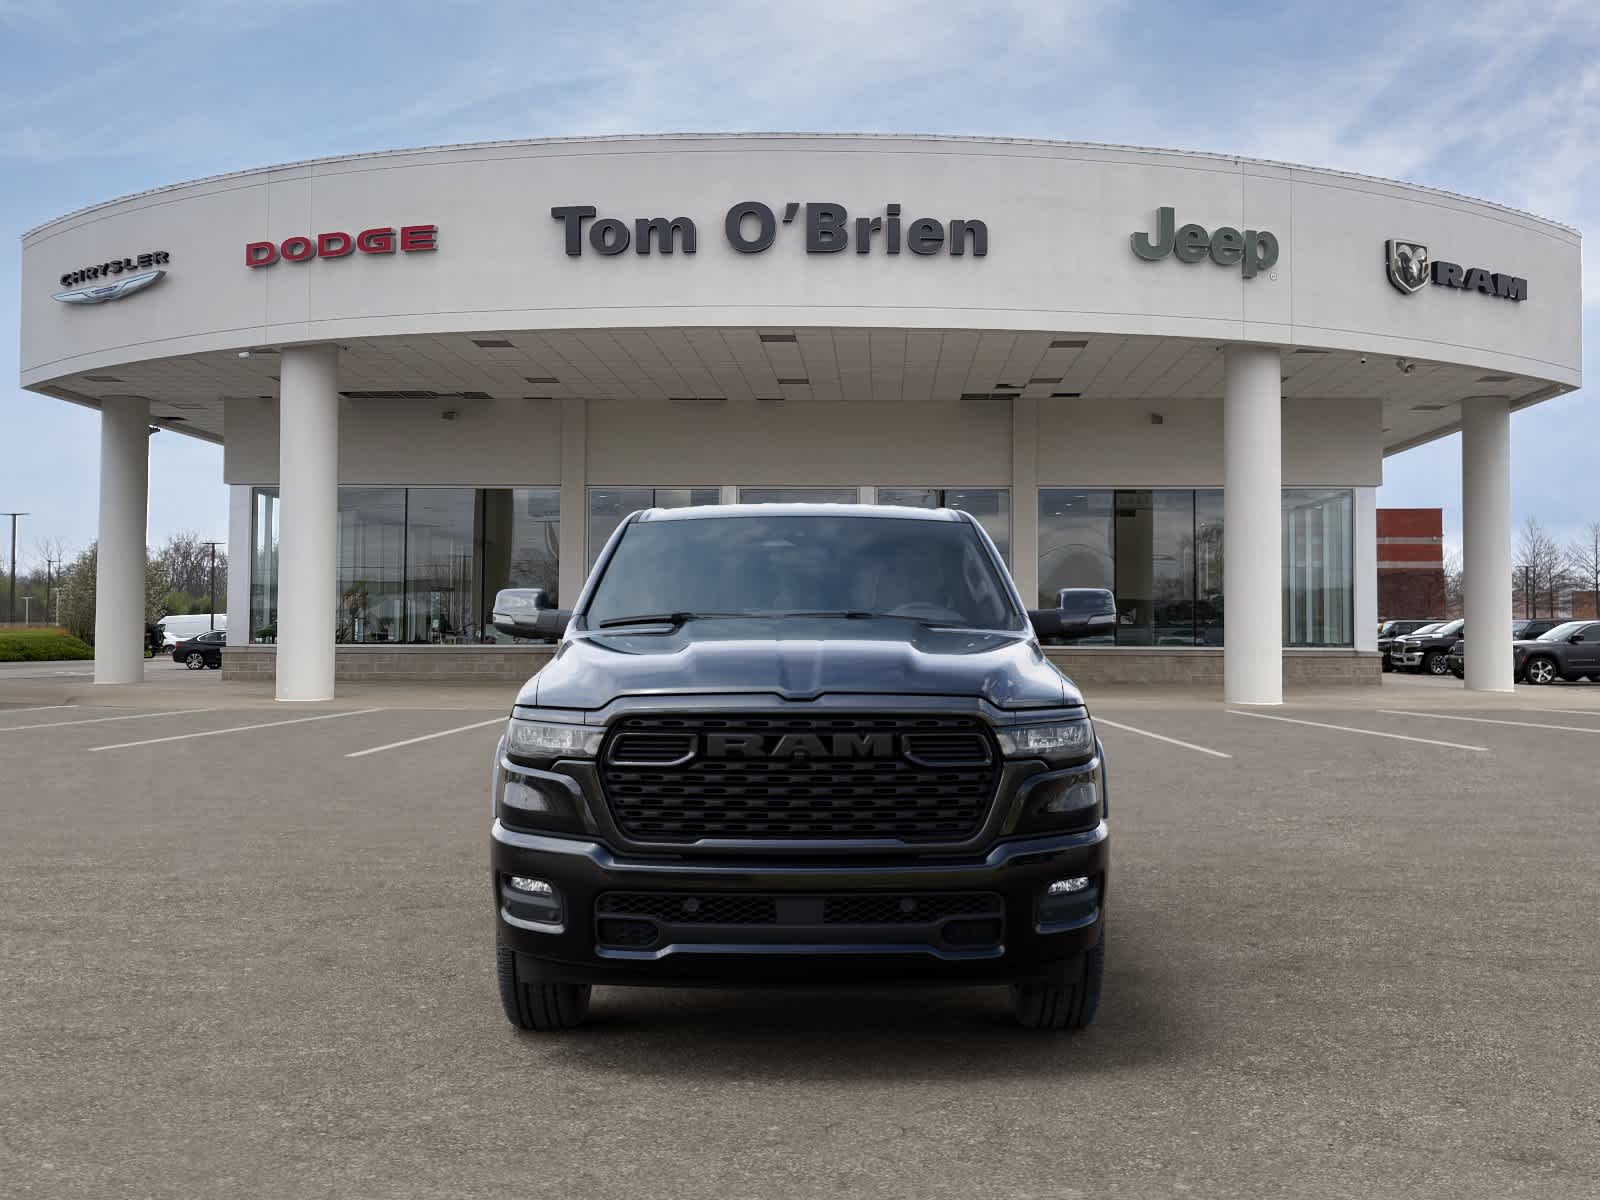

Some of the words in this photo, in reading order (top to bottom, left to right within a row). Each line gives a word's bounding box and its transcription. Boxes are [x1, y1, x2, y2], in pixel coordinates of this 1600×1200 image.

[245, 224, 437, 269] DODGE
[550, 205, 697, 256] Tom
[725, 201, 989, 257] O'Brien
[1130, 206, 1280, 279] Jeep
[60, 250, 170, 287] CHRYSLER
[1431, 260, 1528, 301] RAM
[706, 733, 893, 757] RAM
